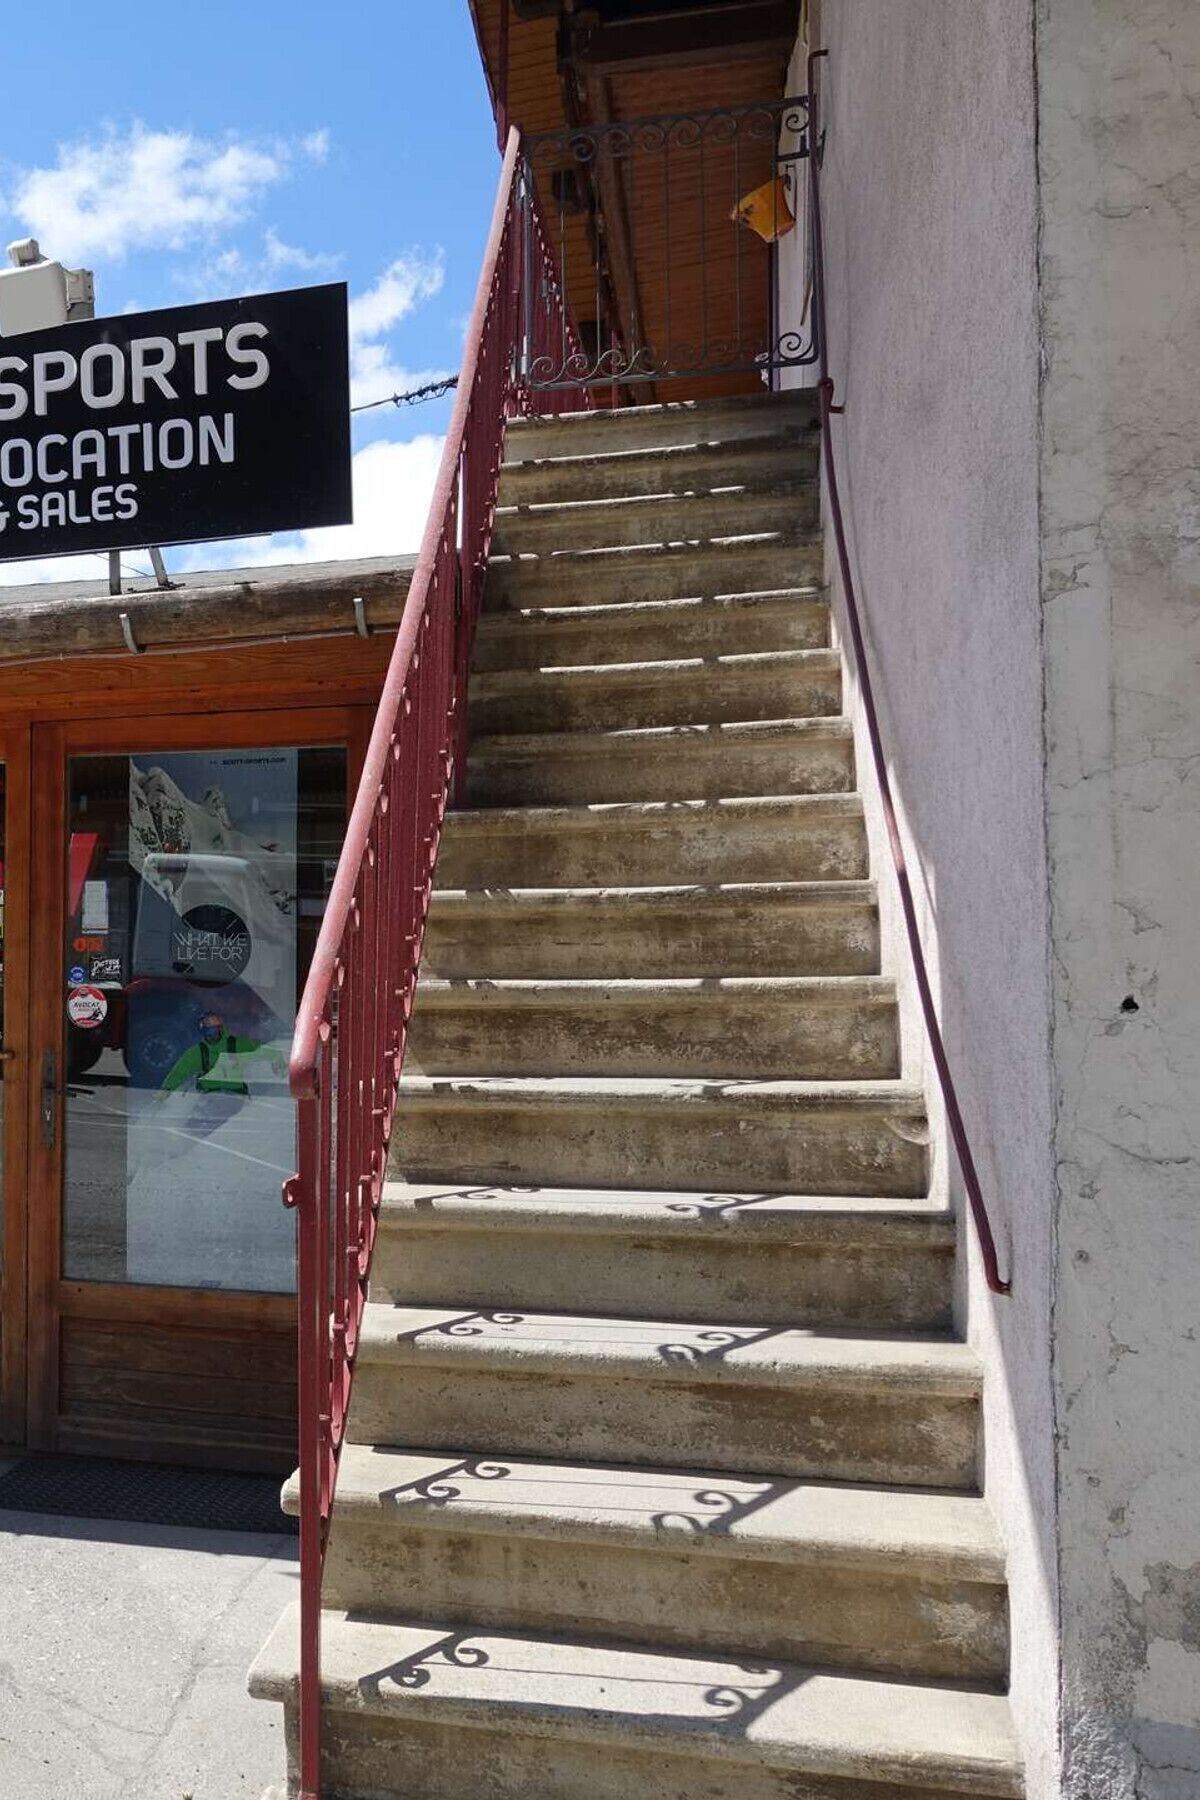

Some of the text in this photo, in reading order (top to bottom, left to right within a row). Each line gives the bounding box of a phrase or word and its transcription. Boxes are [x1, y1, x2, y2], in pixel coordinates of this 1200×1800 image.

[17, 483, 138, 531] SALES
[173, 932, 252, 947] WHAT WE
[177, 946, 243, 960] LIVE FOR
